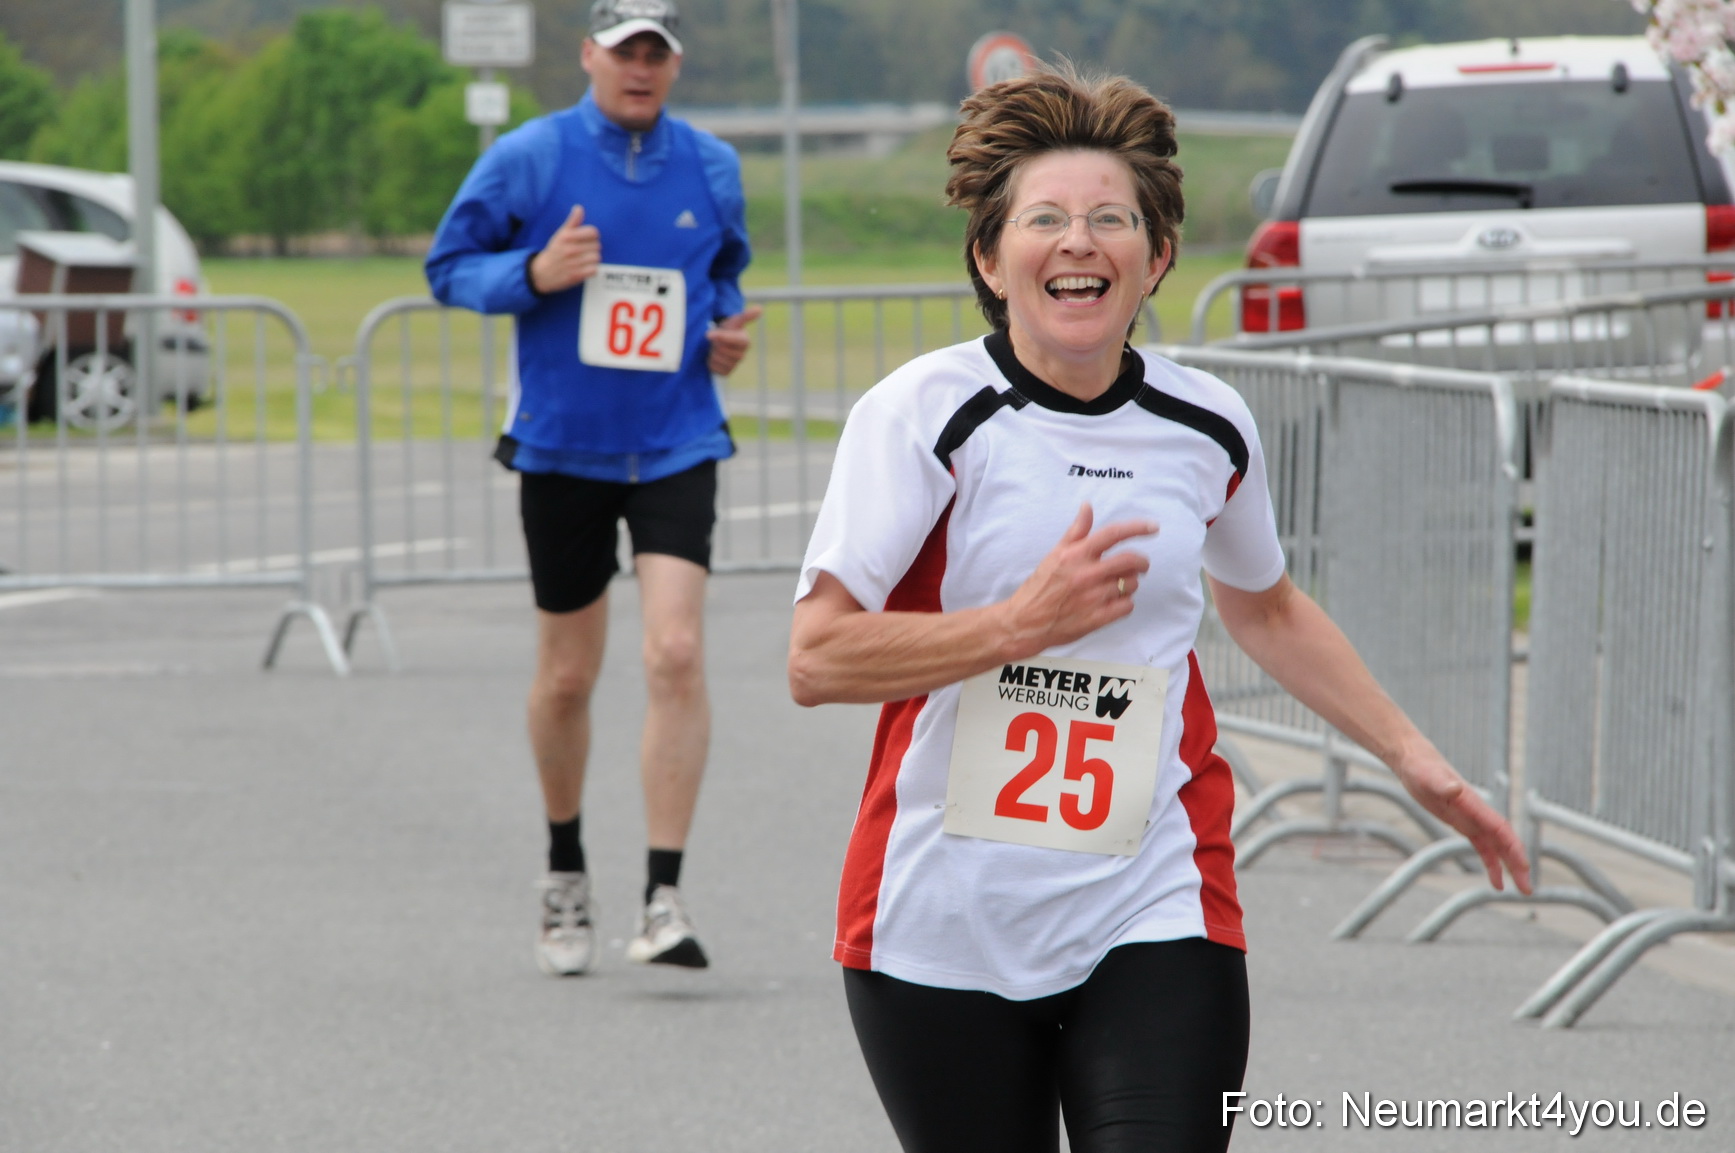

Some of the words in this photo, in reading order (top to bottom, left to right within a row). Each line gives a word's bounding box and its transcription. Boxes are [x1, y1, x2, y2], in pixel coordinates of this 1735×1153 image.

[607, 301, 665, 359] 62
[998, 685, 1090, 711] WERBUNG
[999, 664, 1092, 694] MEYER
[994, 711, 1116, 831] 25
